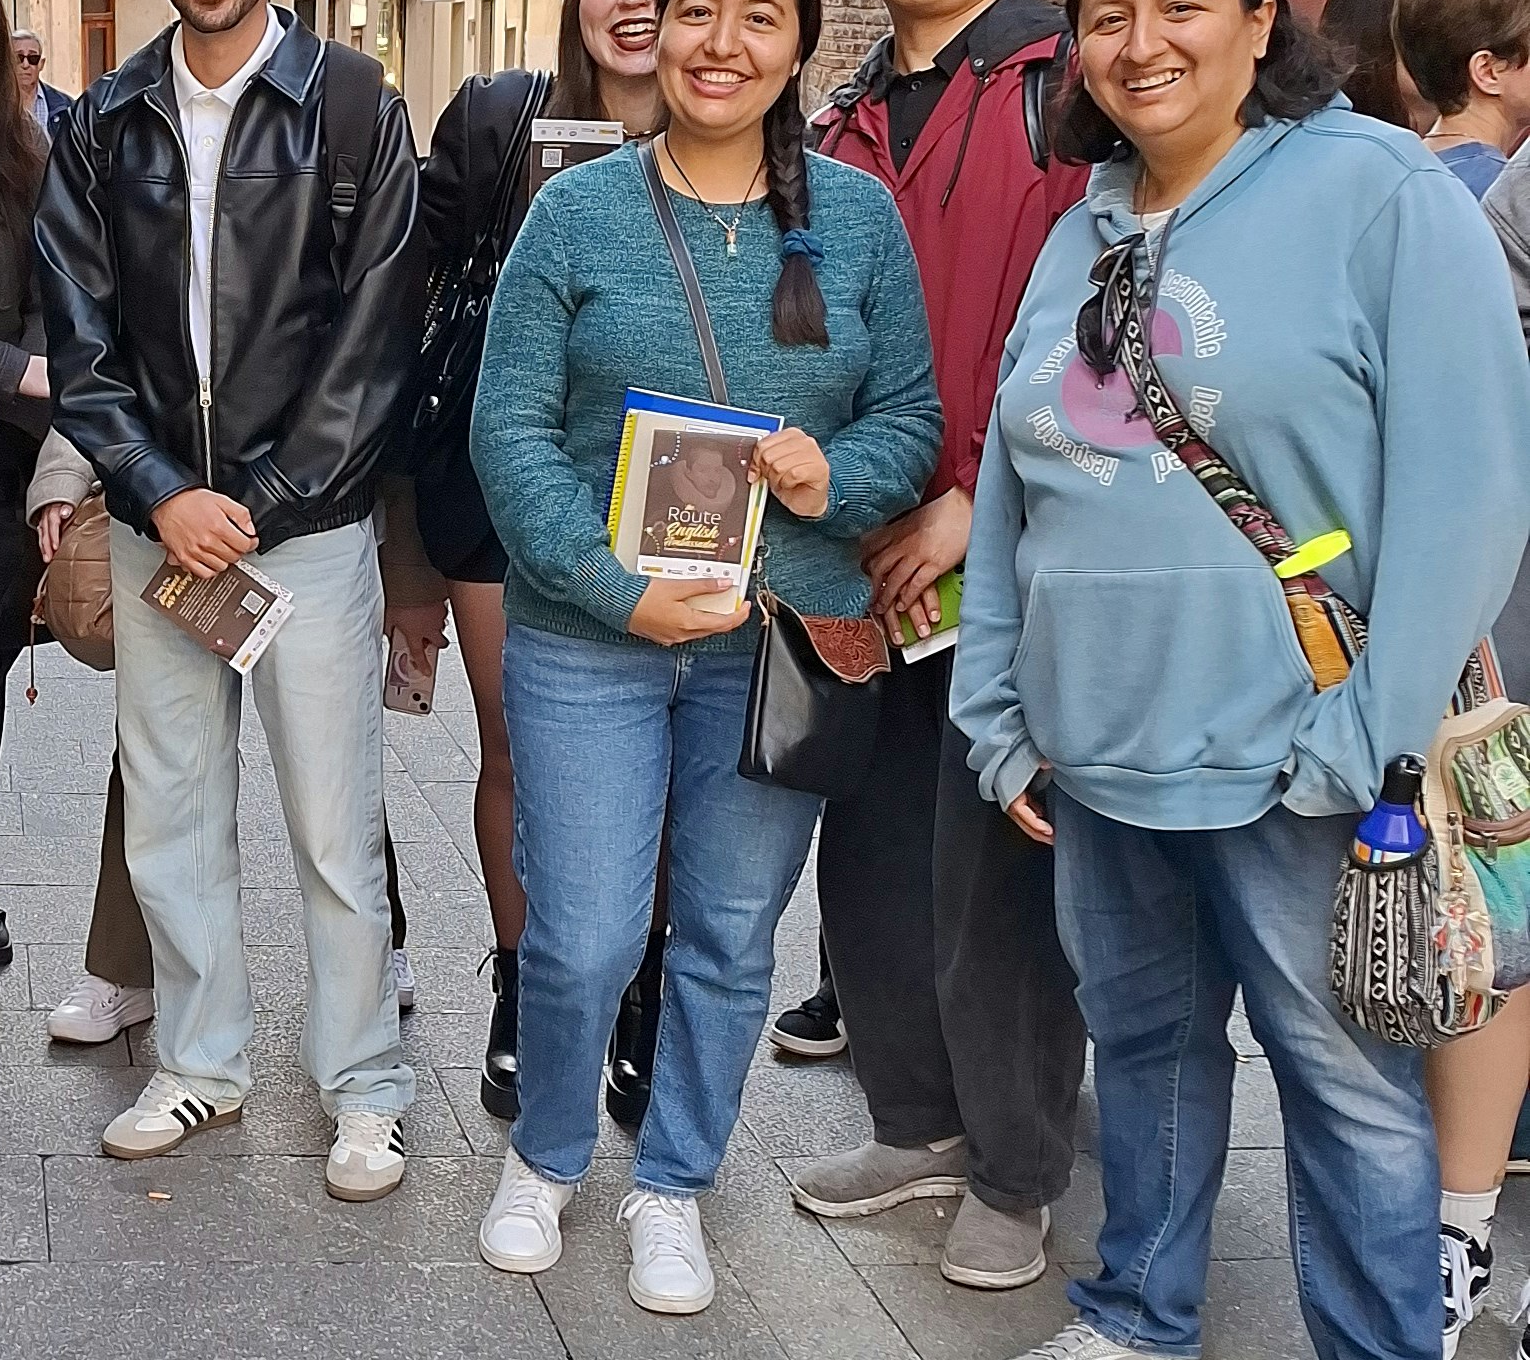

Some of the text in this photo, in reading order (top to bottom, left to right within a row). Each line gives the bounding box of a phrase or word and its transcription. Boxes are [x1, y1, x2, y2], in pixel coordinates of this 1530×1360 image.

[1159, 269, 1227, 358] Accountable
[1026, 405, 1120, 486] Respectful
[666, 522, 720, 540] English
[668, 506, 721, 525] Route
